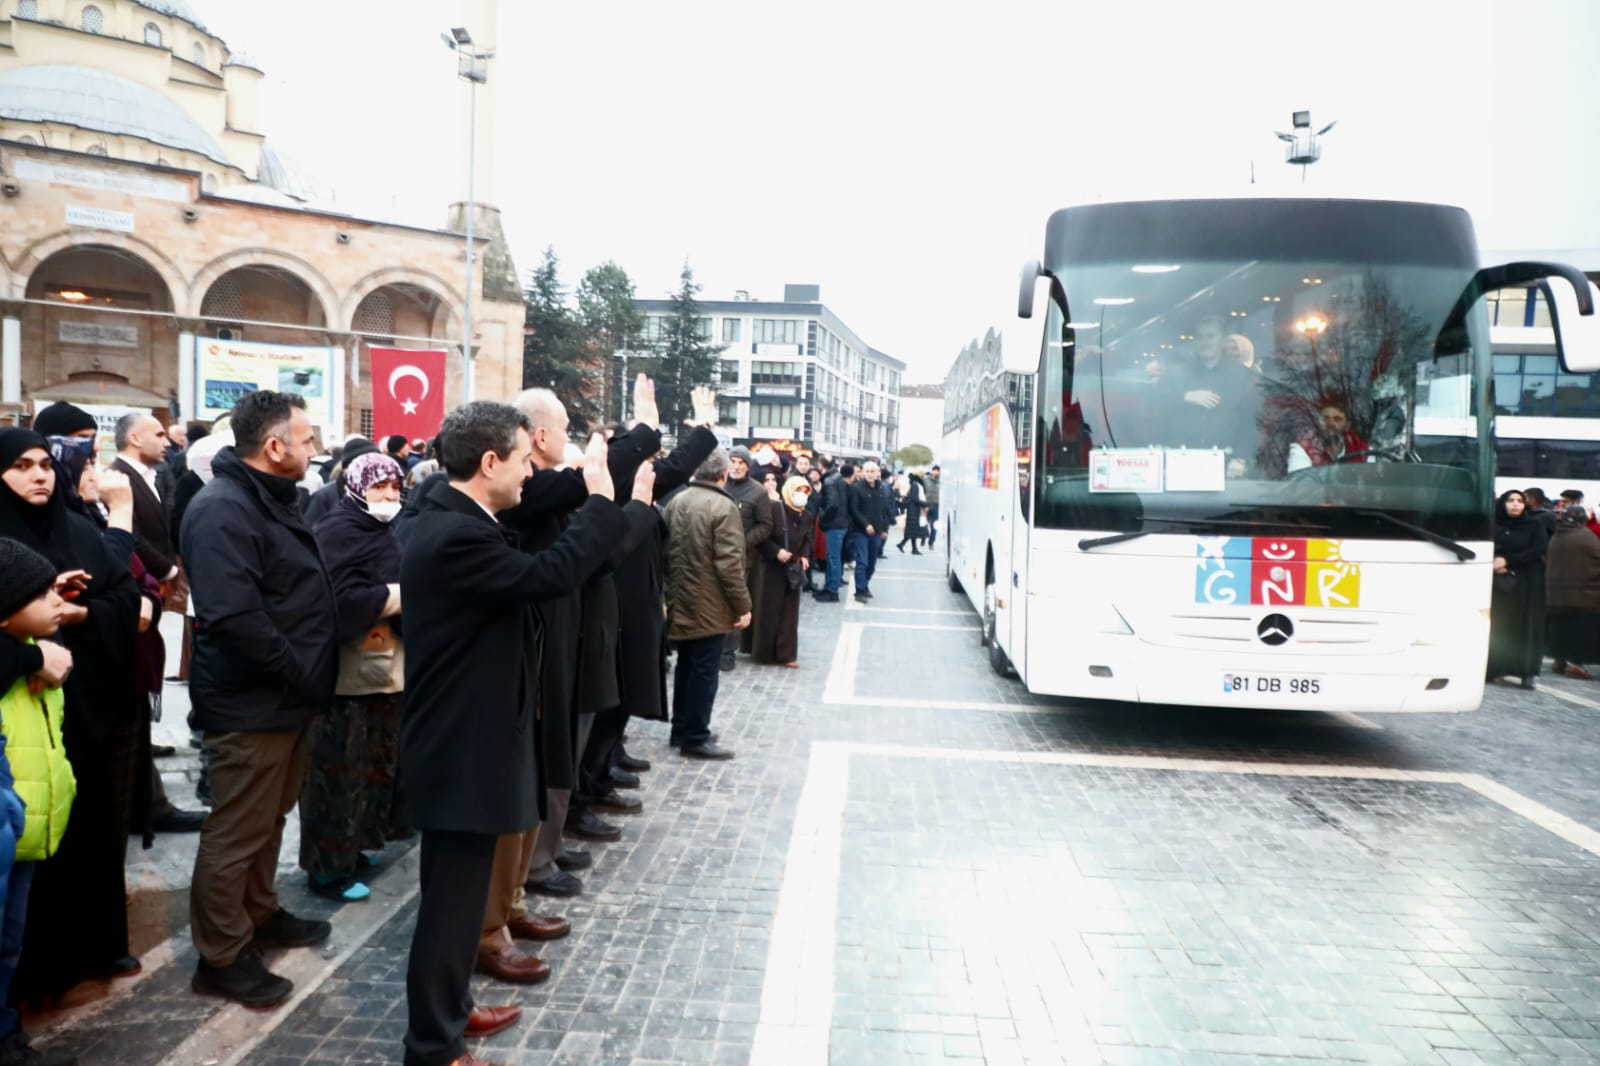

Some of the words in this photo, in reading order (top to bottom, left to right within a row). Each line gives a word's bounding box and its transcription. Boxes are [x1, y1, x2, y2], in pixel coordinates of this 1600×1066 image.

[1232, 677, 1249, 691] 81
[1257, 677, 1281, 692] DB
[1290, 679, 1320, 693] 985
